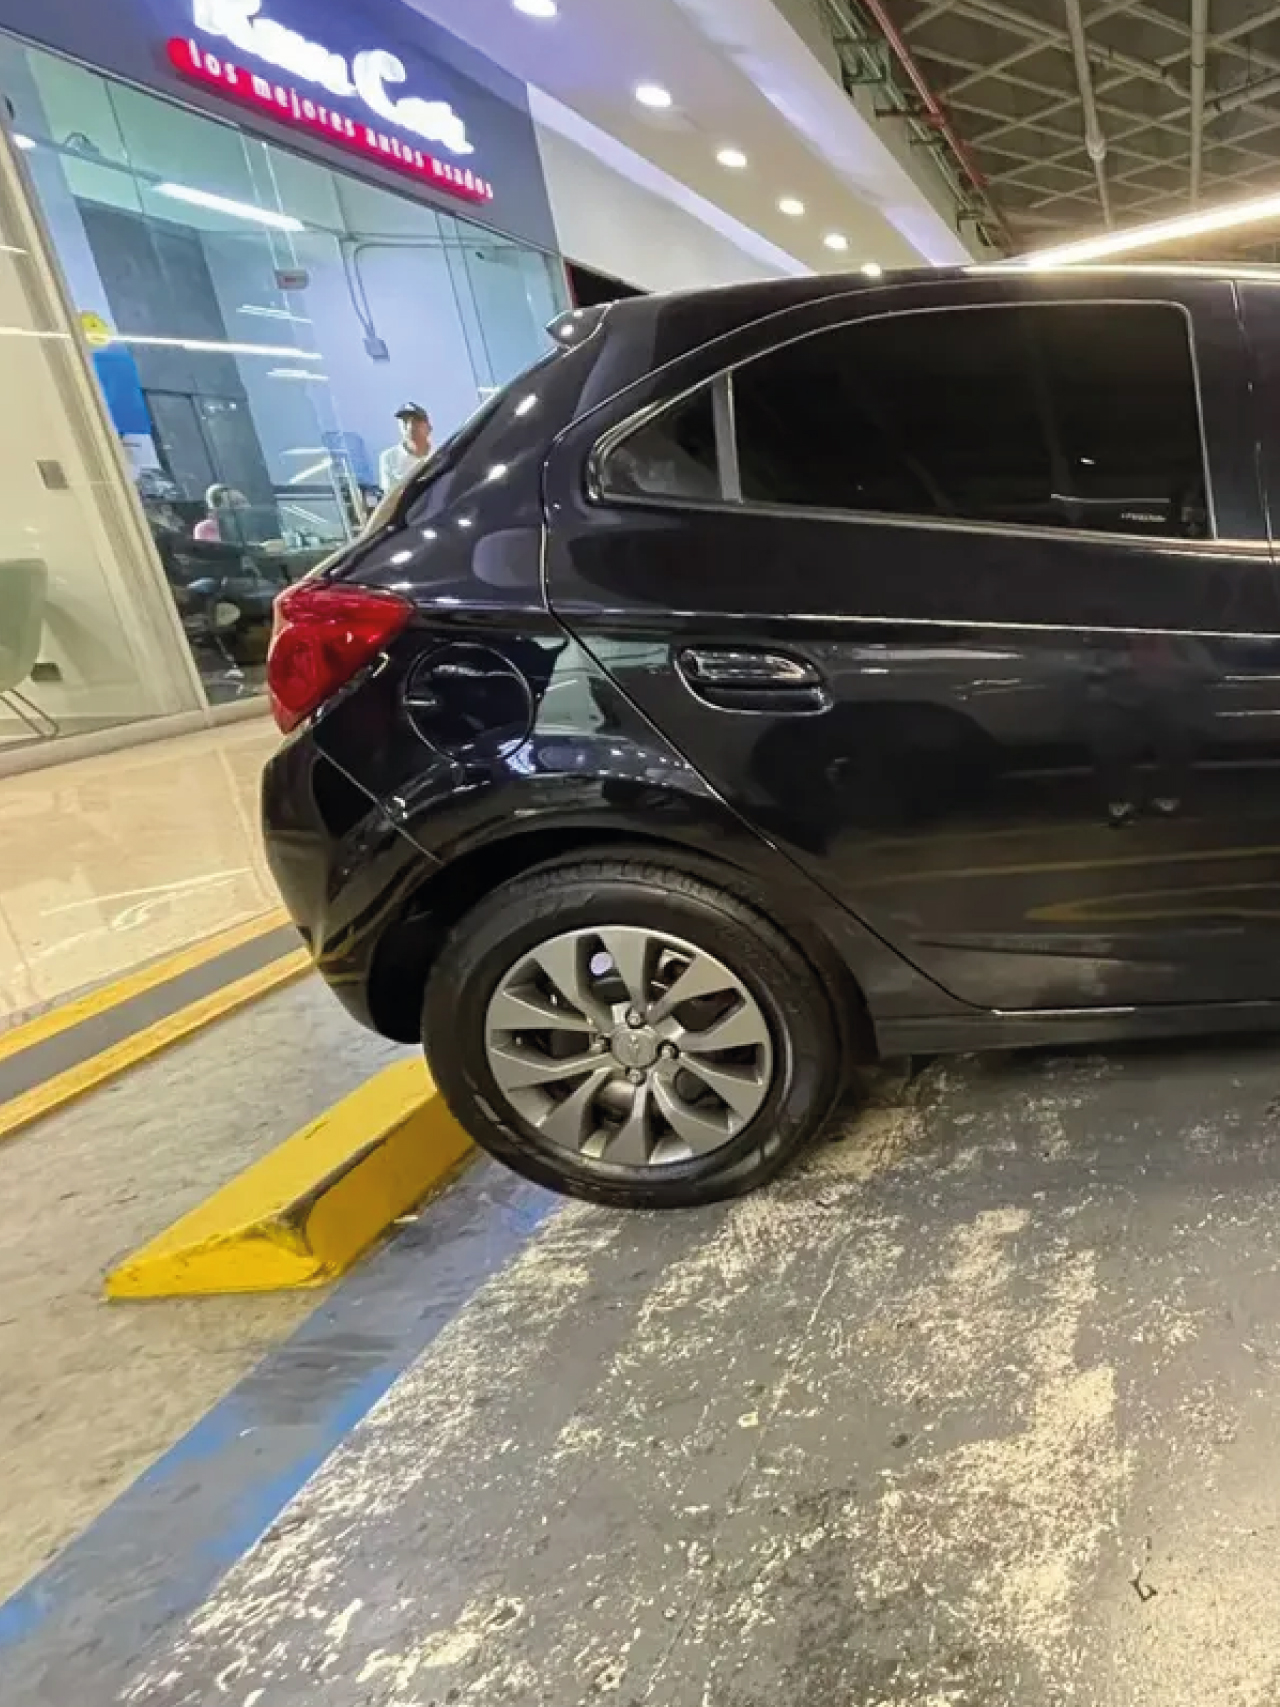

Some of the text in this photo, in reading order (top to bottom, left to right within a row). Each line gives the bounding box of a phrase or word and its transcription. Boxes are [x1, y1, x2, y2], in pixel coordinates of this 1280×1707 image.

[188, 38, 494, 200] los mejores autos usados
